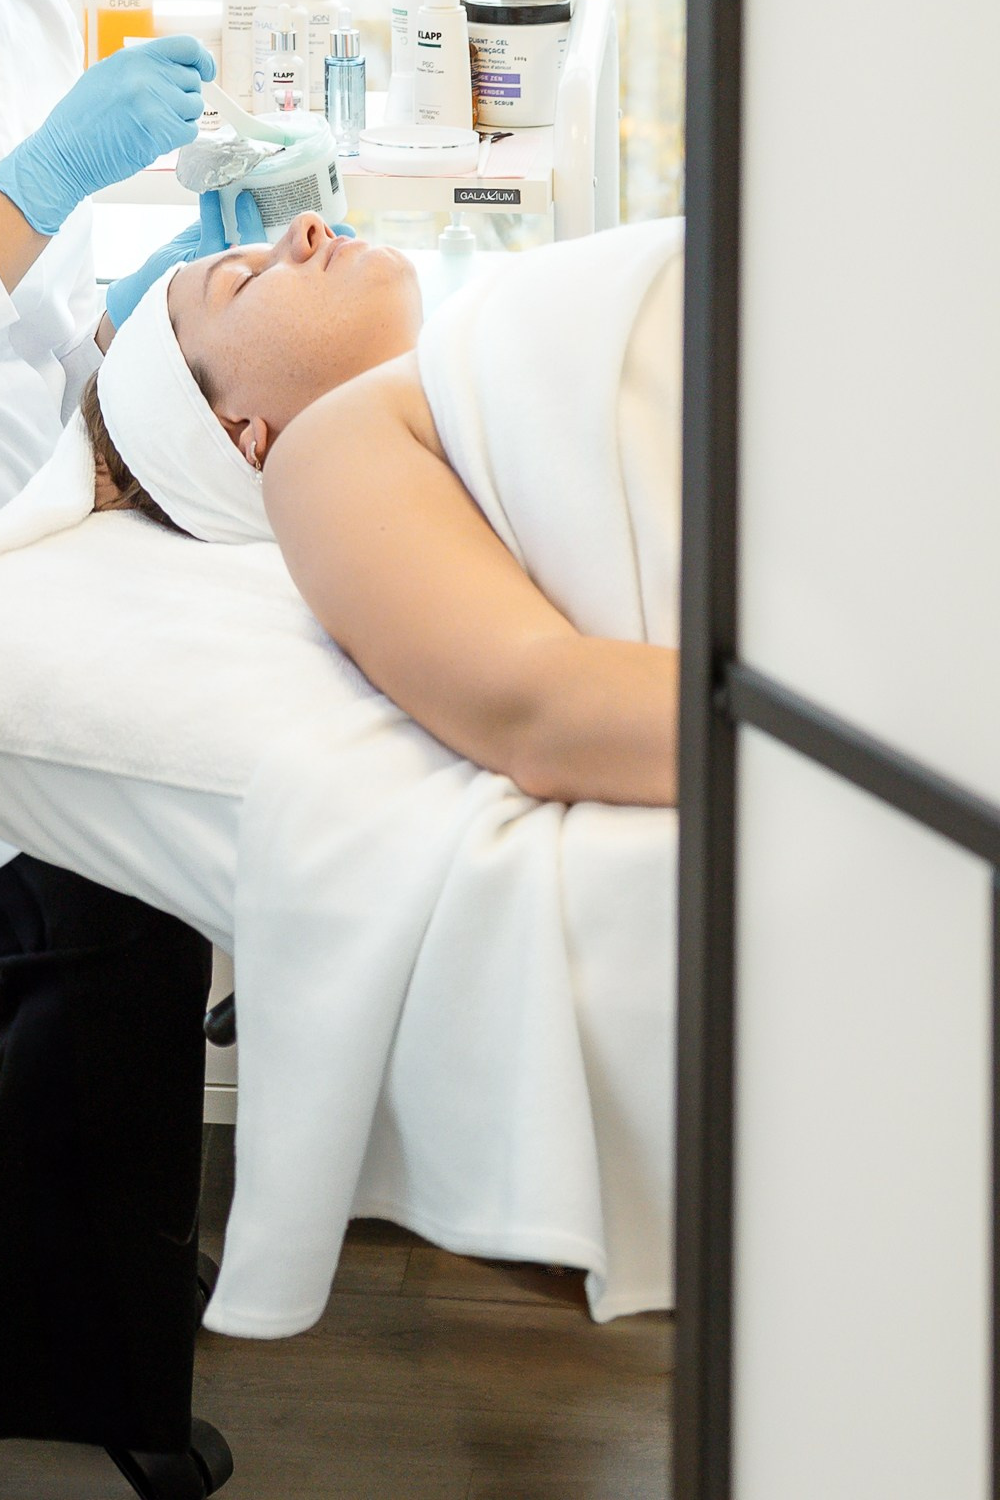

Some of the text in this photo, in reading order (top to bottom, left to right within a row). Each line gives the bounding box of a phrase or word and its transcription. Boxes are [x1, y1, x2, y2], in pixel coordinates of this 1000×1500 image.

[109, 0, 141, 7] C PURE
[417, 30, 442, 41] KLAPP
[422, 60, 434, 68] PSC
[460, 191, 514, 201] GALAXIUM
